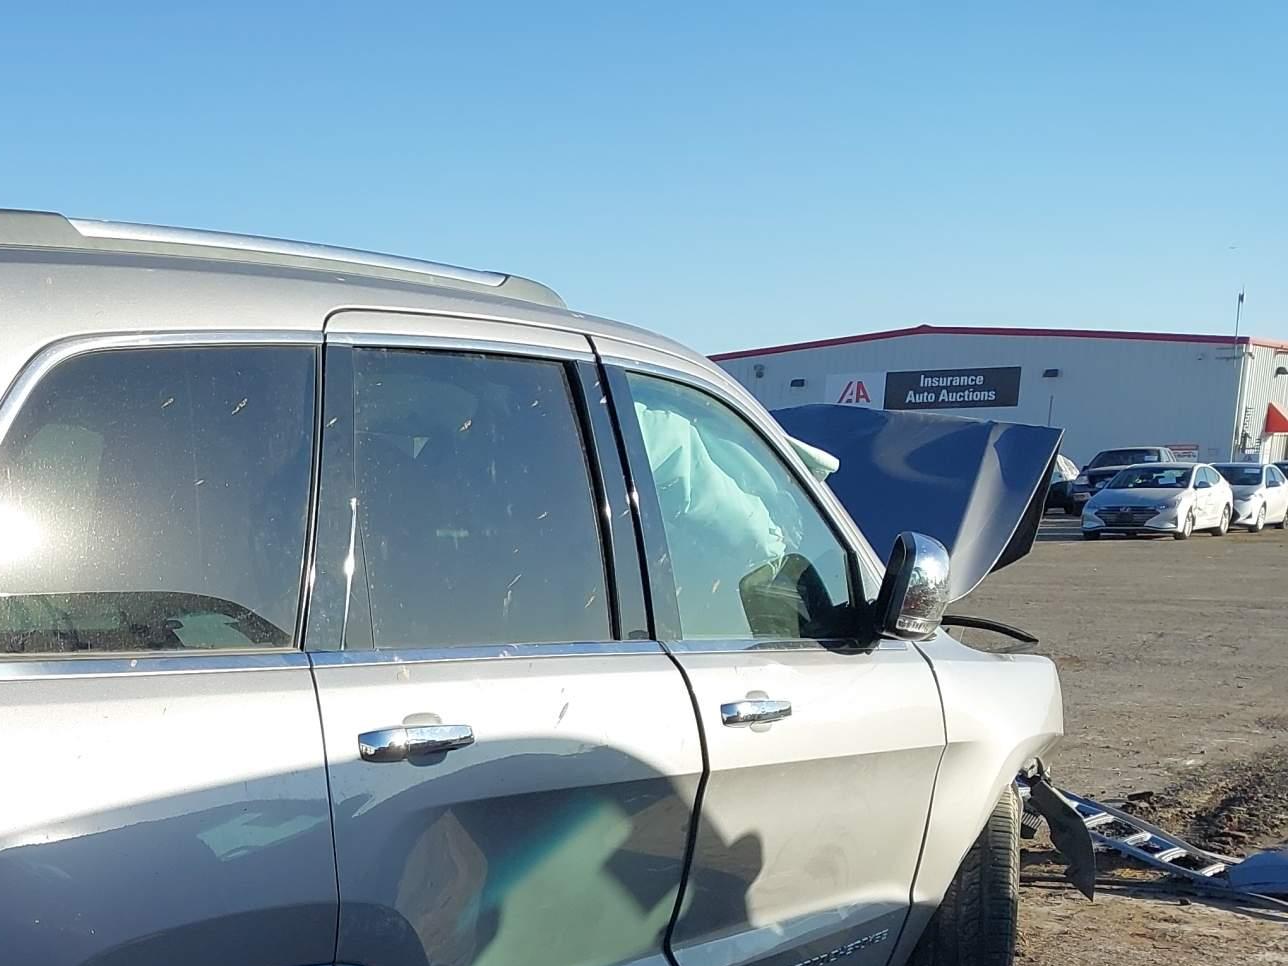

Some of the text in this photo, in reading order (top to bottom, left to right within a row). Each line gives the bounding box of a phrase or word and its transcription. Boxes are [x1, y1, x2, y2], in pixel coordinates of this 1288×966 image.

[920, 374, 984, 388] Insurance
[906, 388, 996, 404] Auto Auctions
